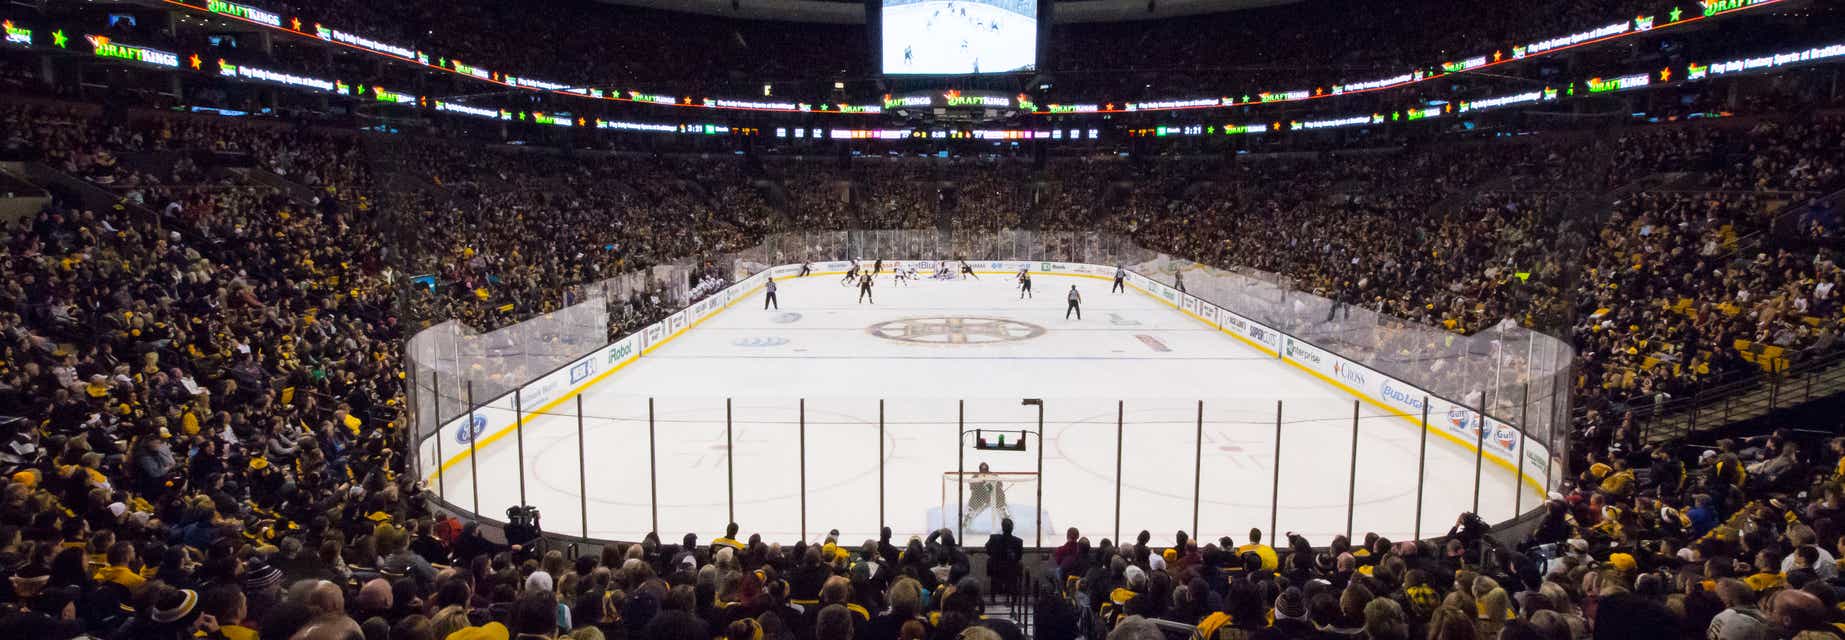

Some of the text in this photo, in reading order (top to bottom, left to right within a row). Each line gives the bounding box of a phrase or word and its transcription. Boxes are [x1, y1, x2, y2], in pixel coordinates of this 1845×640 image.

[96, 43, 178, 67] DRAFTKINGS
[886, 97, 931, 109] DRAFTKINGS
[949, 96, 1009, 106] DRAFTKINGS
[608, 340, 632, 364] iRobot
[1384, 386, 1404, 401] BUD
[1496, 430, 1514, 440] Gulf
